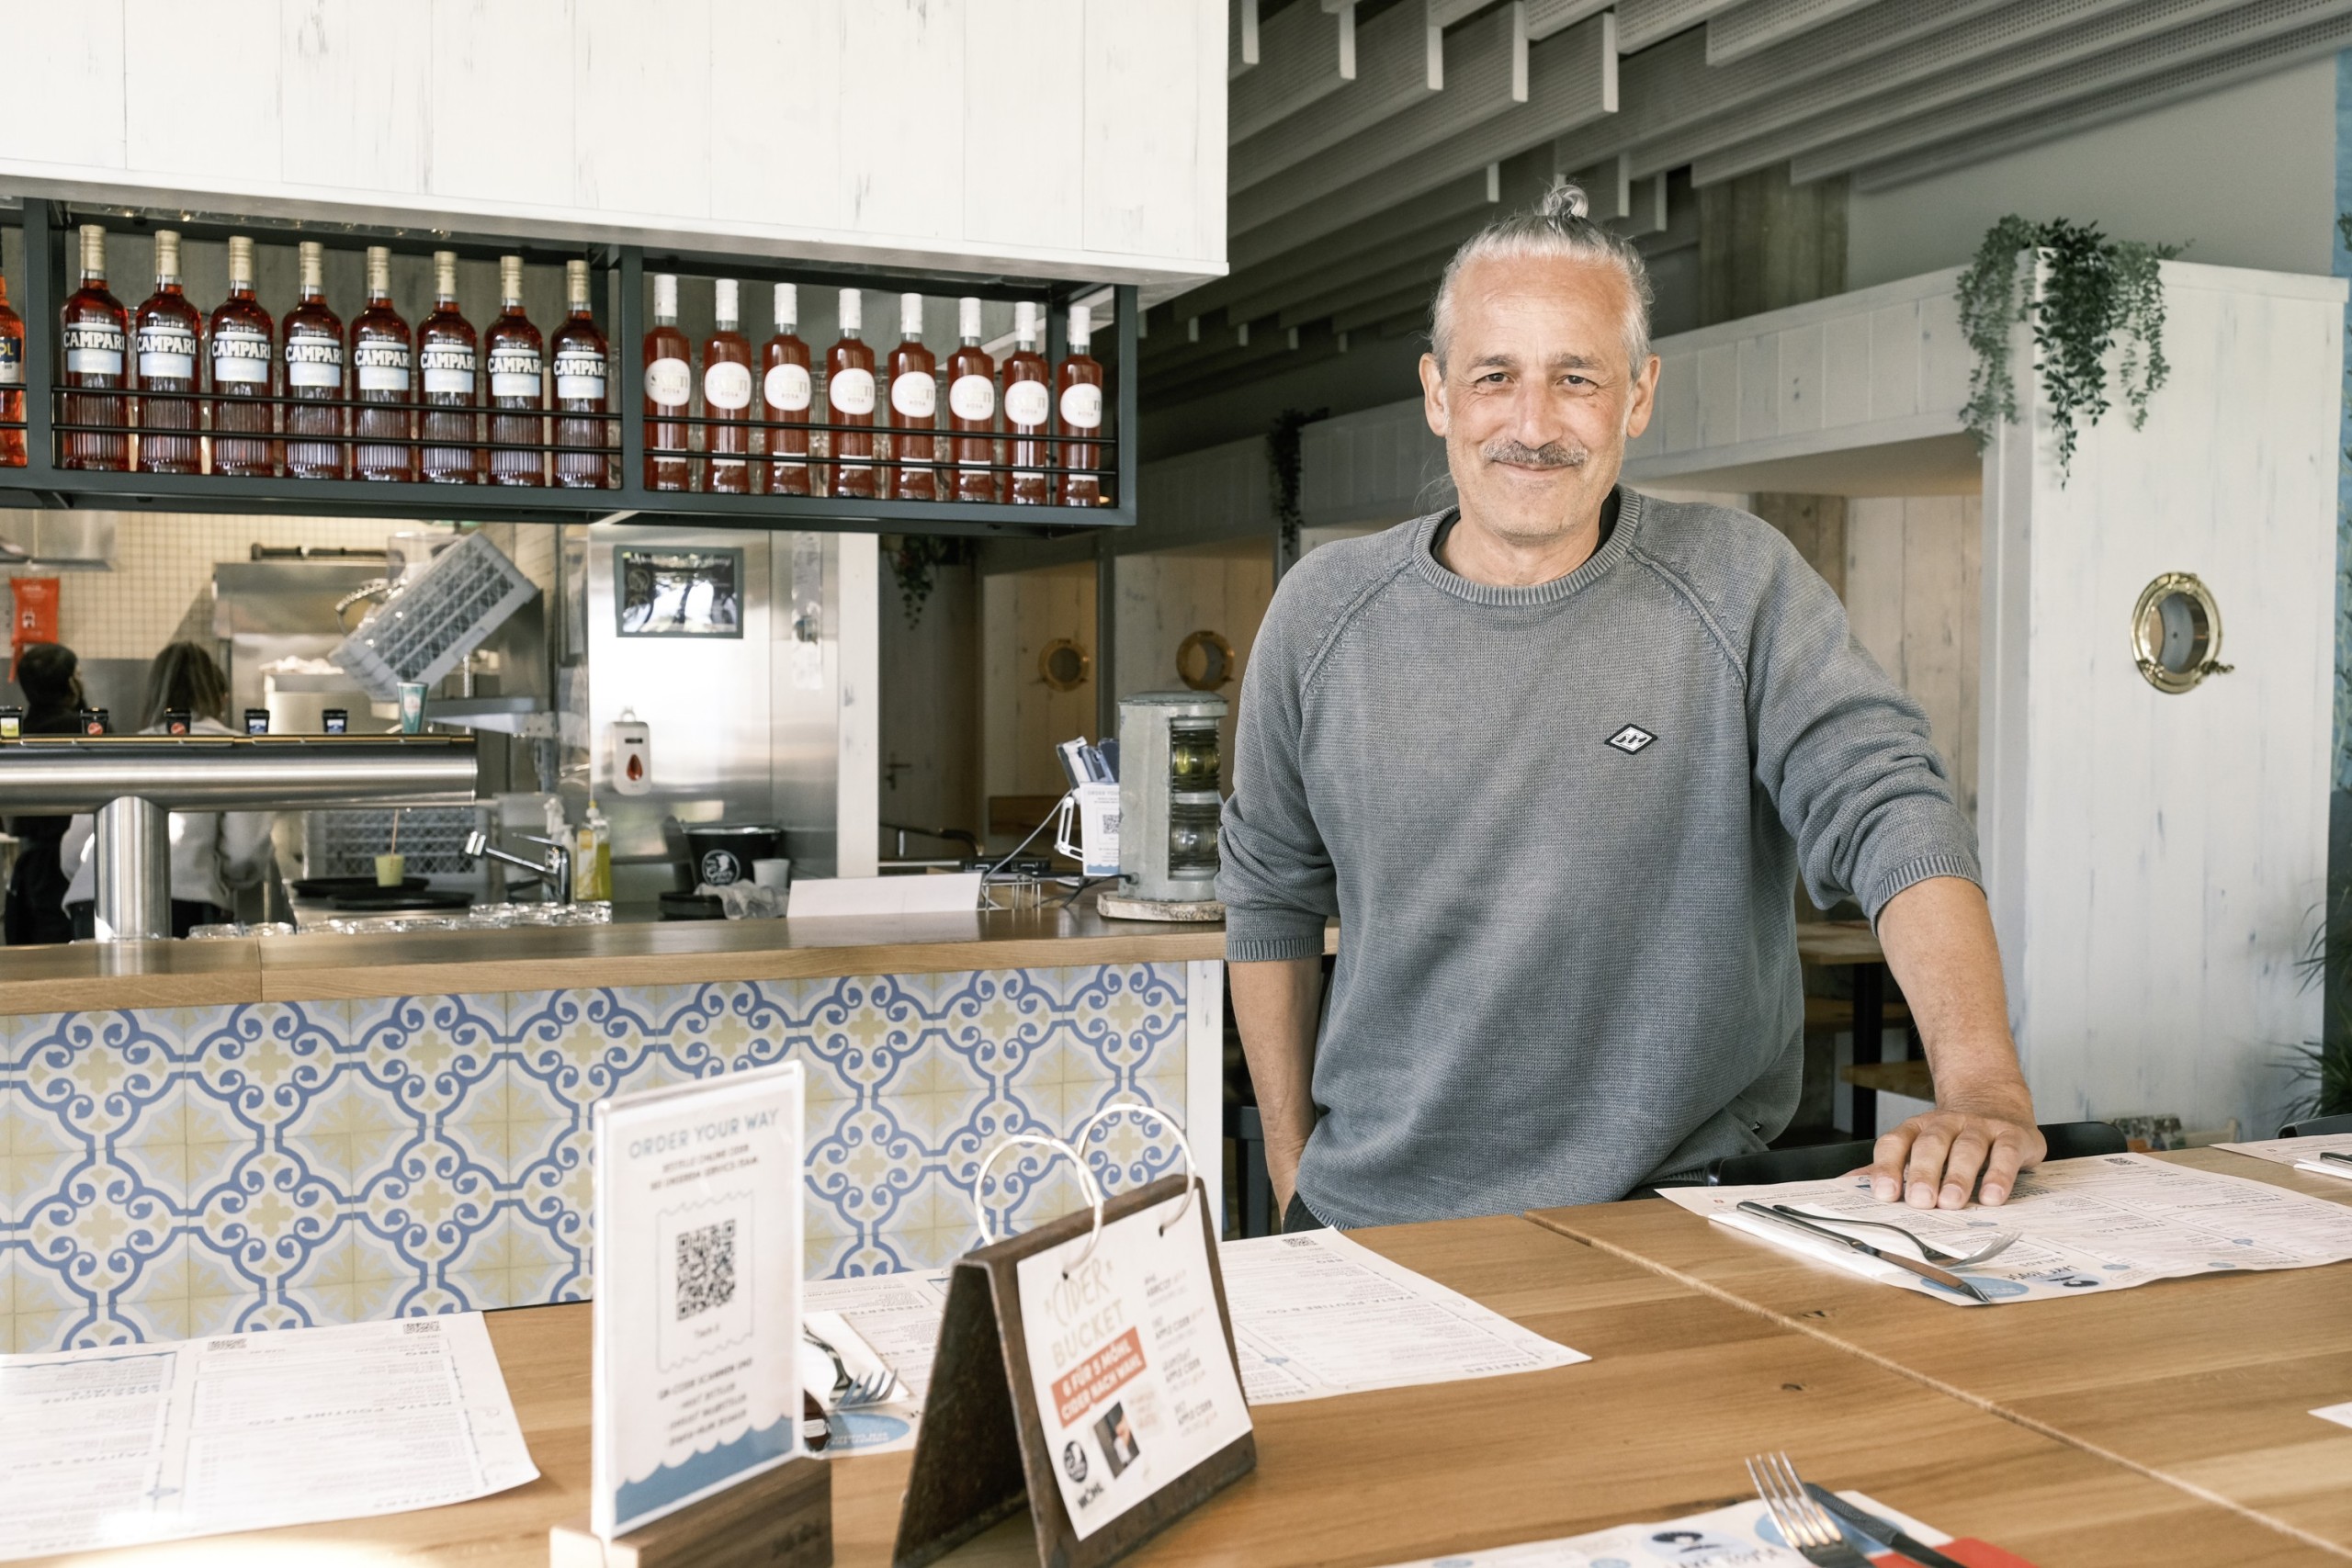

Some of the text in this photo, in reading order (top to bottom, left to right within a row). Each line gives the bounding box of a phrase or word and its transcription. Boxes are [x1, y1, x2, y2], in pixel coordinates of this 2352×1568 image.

[63, 331, 126, 351] CAMPARI
[137, 335, 197, 355] CAMPARI
[211, 341, 271, 359] CAMPARI
[285, 345, 343, 364] CAMPARI
[628, 1107, 780, 1160] ORDER YOUR WAY
[1053, 1258, 1110, 1327] CIDER
[1051, 1298, 1124, 1368] BUCKET
